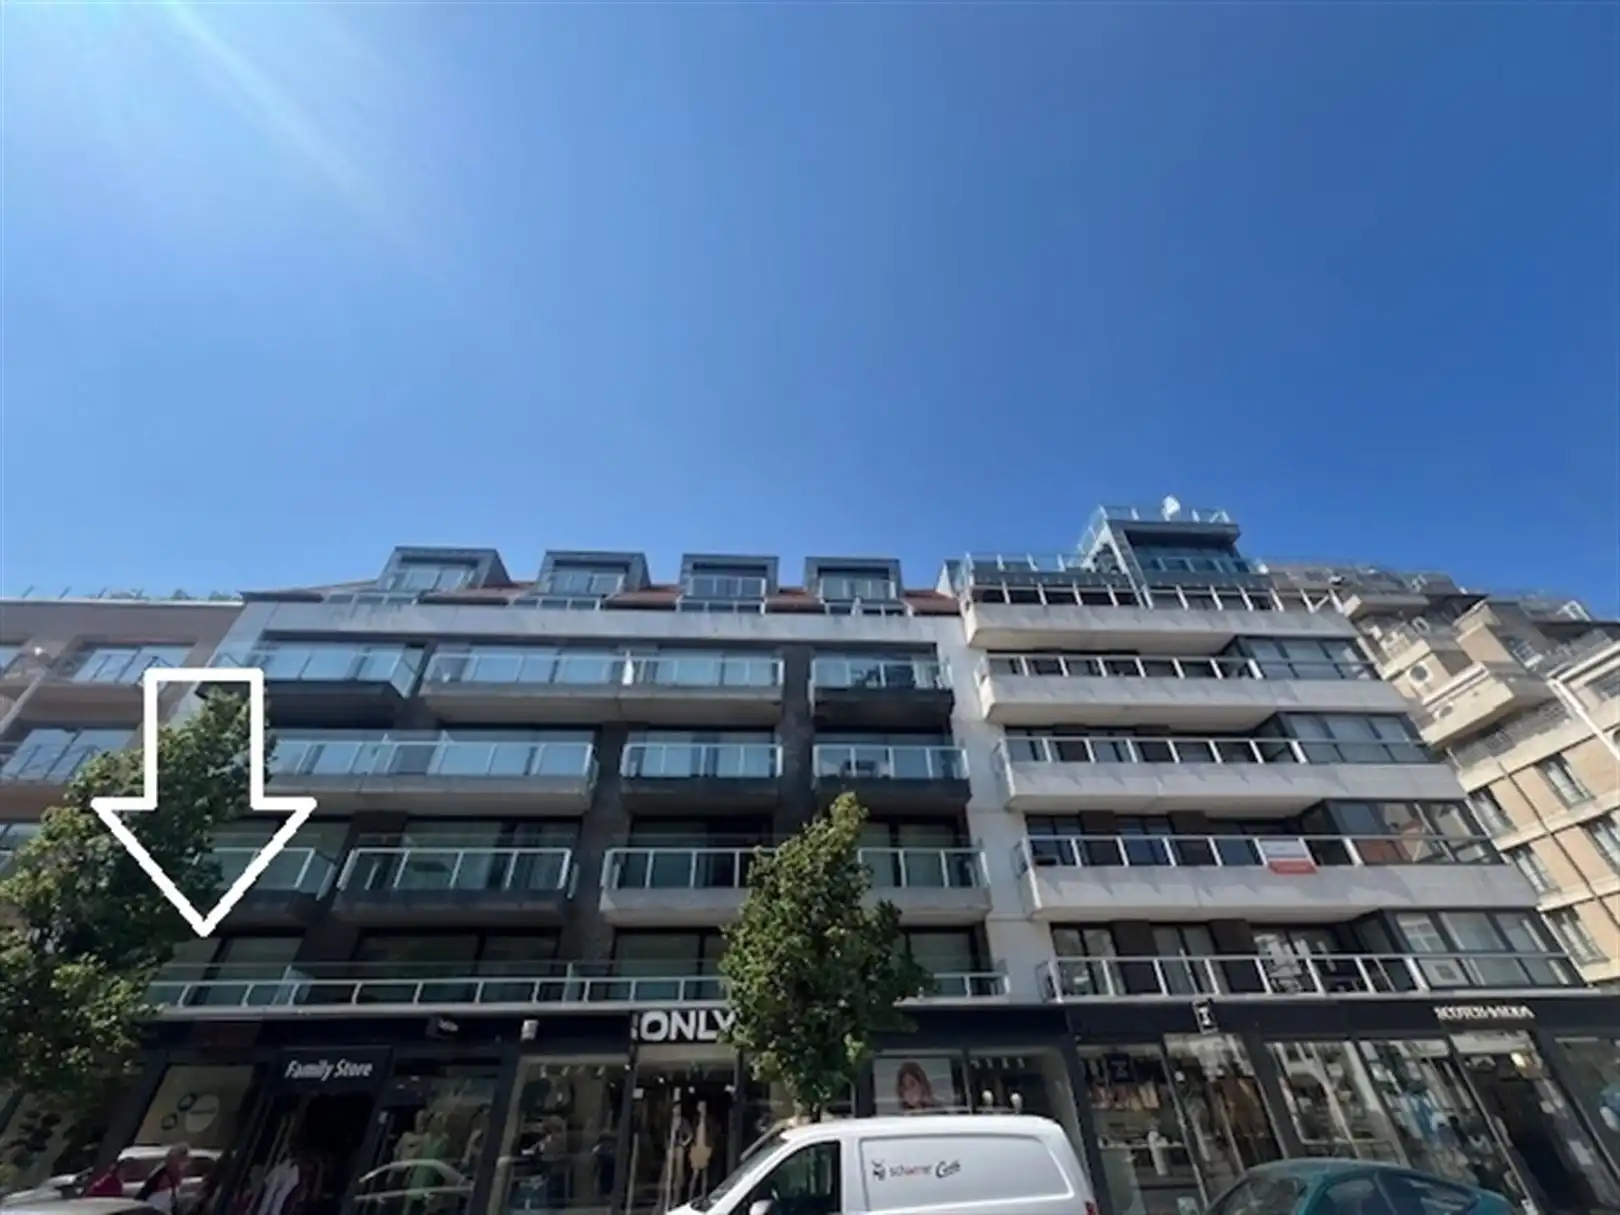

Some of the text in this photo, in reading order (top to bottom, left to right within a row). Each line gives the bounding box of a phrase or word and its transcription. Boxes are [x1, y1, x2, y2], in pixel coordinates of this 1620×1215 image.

[641, 1010, 736, 1041] ONLY
[284, 1059, 373, 1081] Family Store
